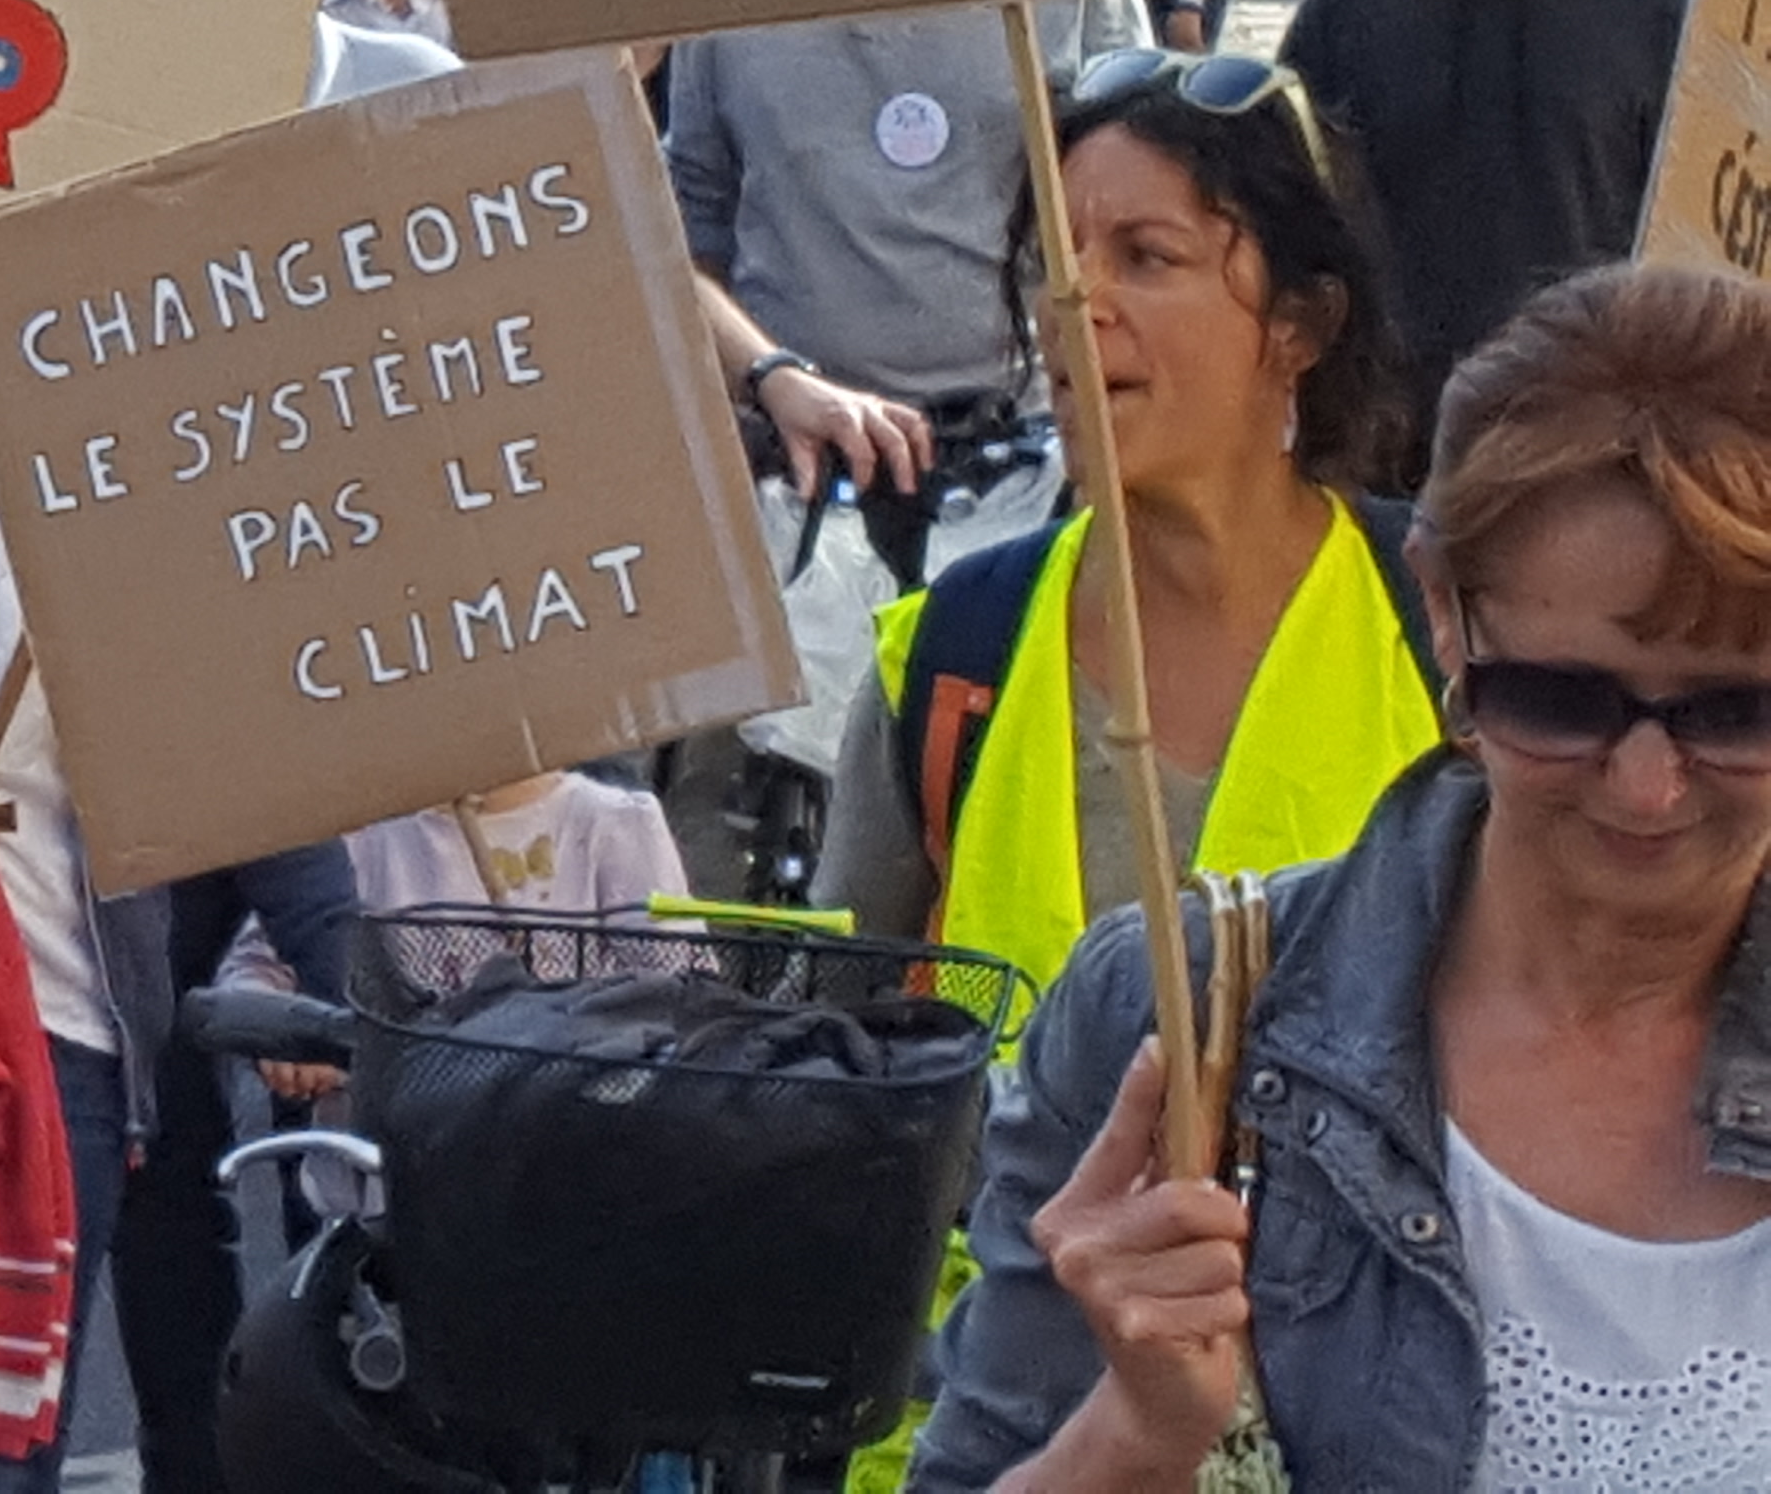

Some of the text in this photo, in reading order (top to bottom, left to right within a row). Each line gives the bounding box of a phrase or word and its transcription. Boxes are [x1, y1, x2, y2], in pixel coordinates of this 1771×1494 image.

[20, 163, 591, 382] CHANGEONS
[32, 314, 545, 514] LE SYSTÈME
[227, 437, 545, 583] PAS LE
